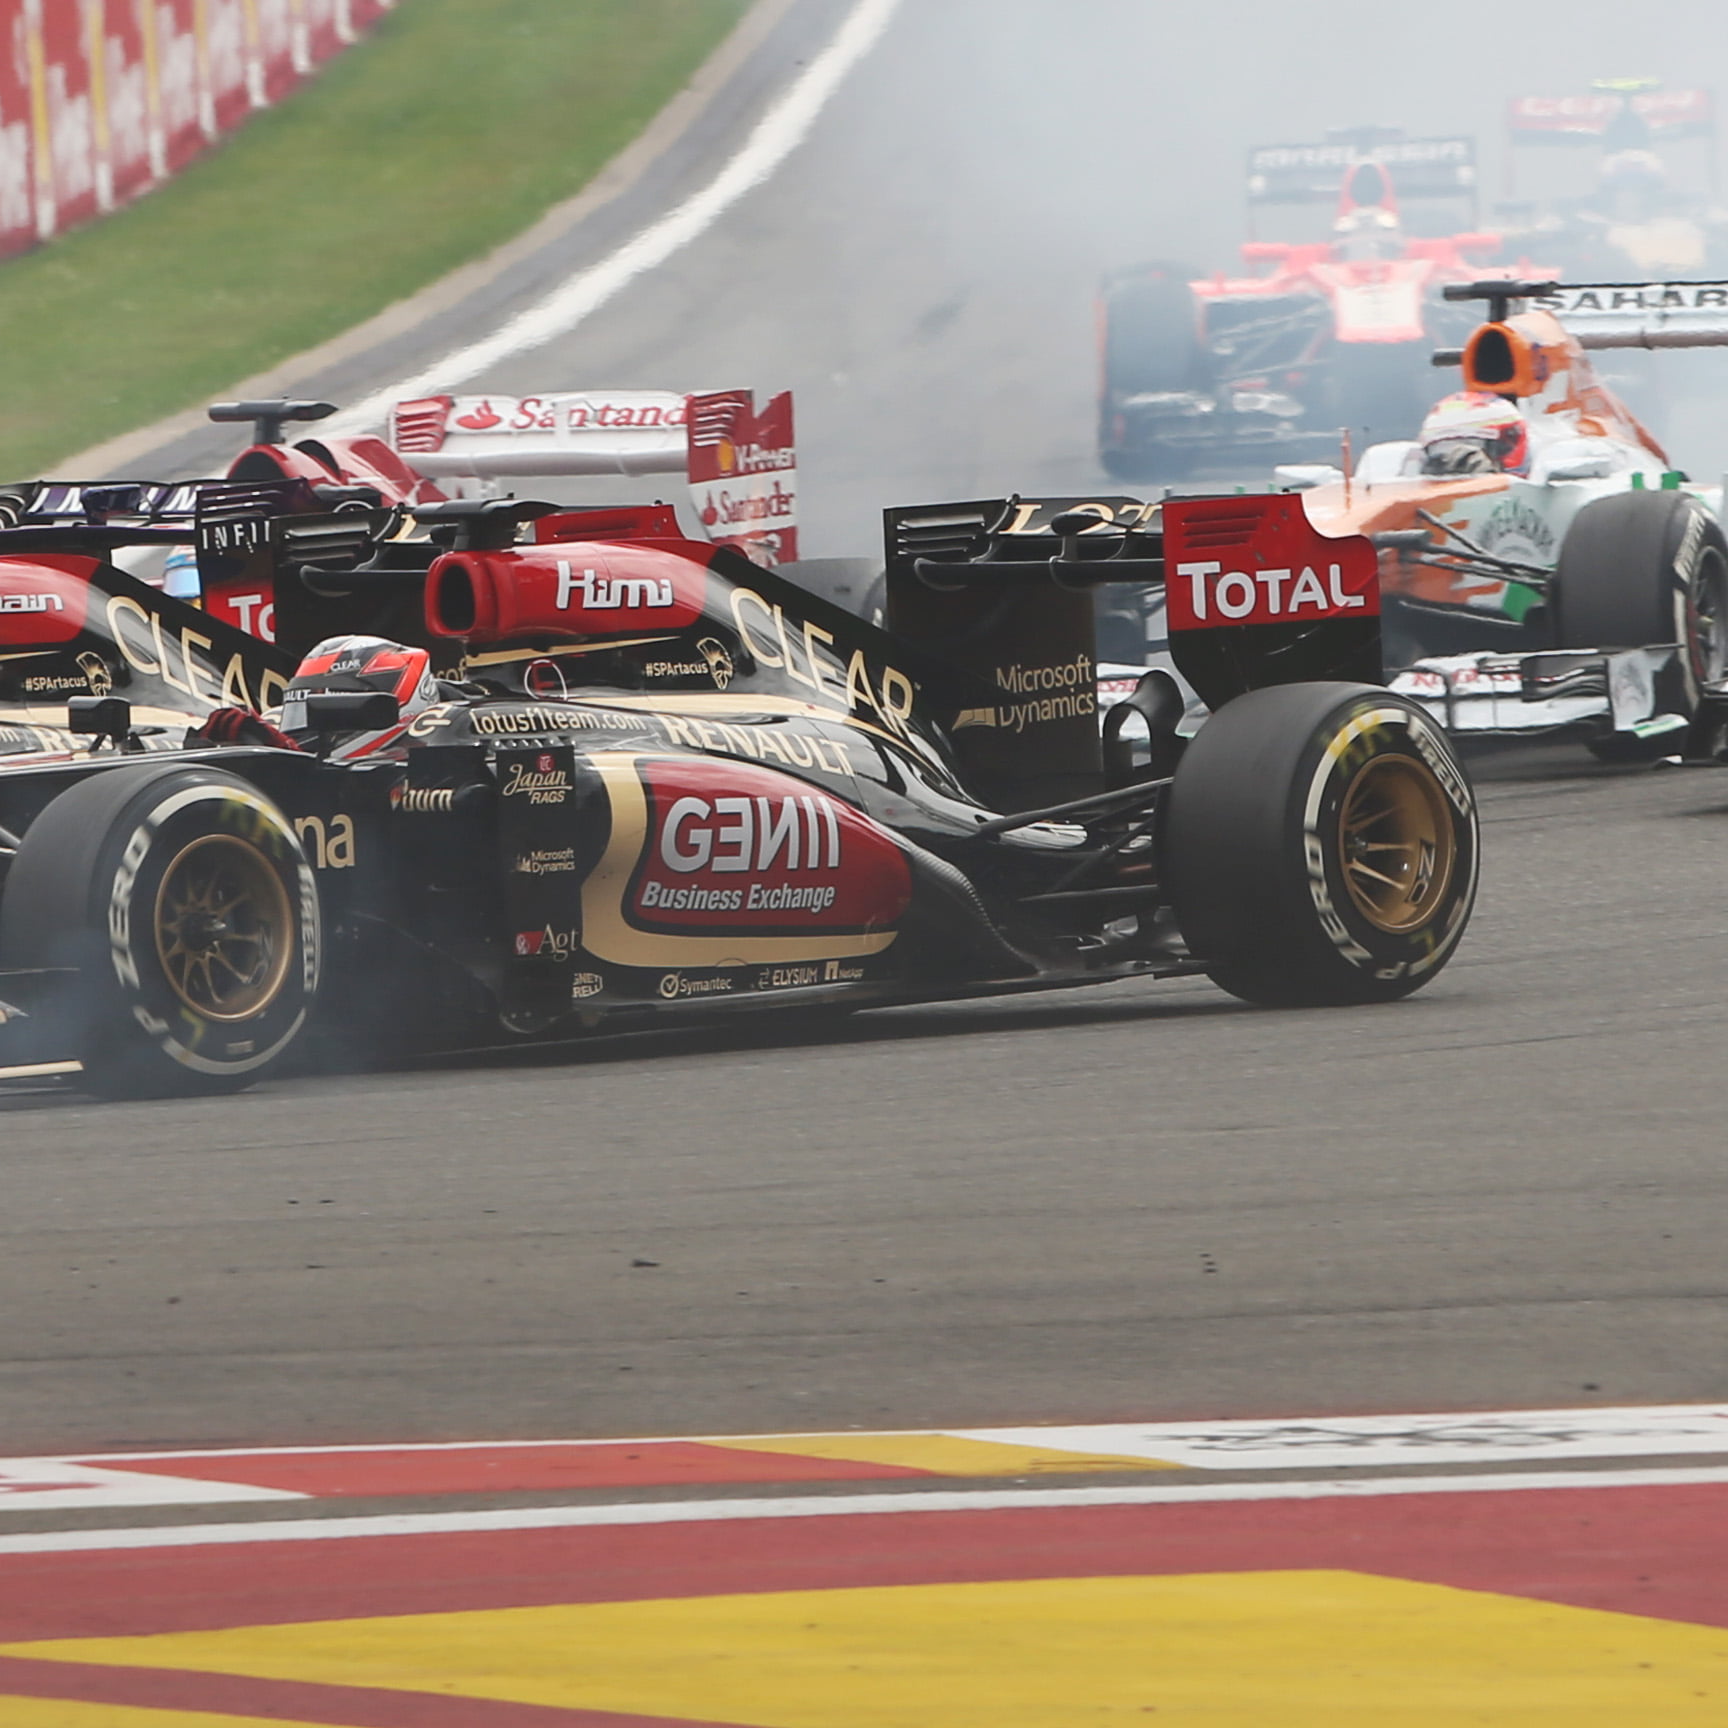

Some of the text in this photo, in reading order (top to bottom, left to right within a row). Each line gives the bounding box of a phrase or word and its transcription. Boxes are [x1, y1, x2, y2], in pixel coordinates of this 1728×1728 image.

[1177, 560, 1366, 622] TOTAL
[645, 661, 709, 678] #SPArtacus
[729, 587, 914, 738] CLEAR
[996, 653, 1093, 695] Microsoft
[24, 675, 88, 693] #SPArtacus
[470, 709, 647, 736] lotusf1team.com
[1000, 689, 1096, 734] Dynamics
[652, 713, 856, 778] RENAULT
[503, 764, 573, 797] Japan
[530, 789, 566, 805] RAGS
[531, 847, 575, 863] Microsoft
[531, 859, 576, 876] Dynamics
[641, 880, 836, 914] Business Exchange
[680, 976, 733, 993] Symantec
